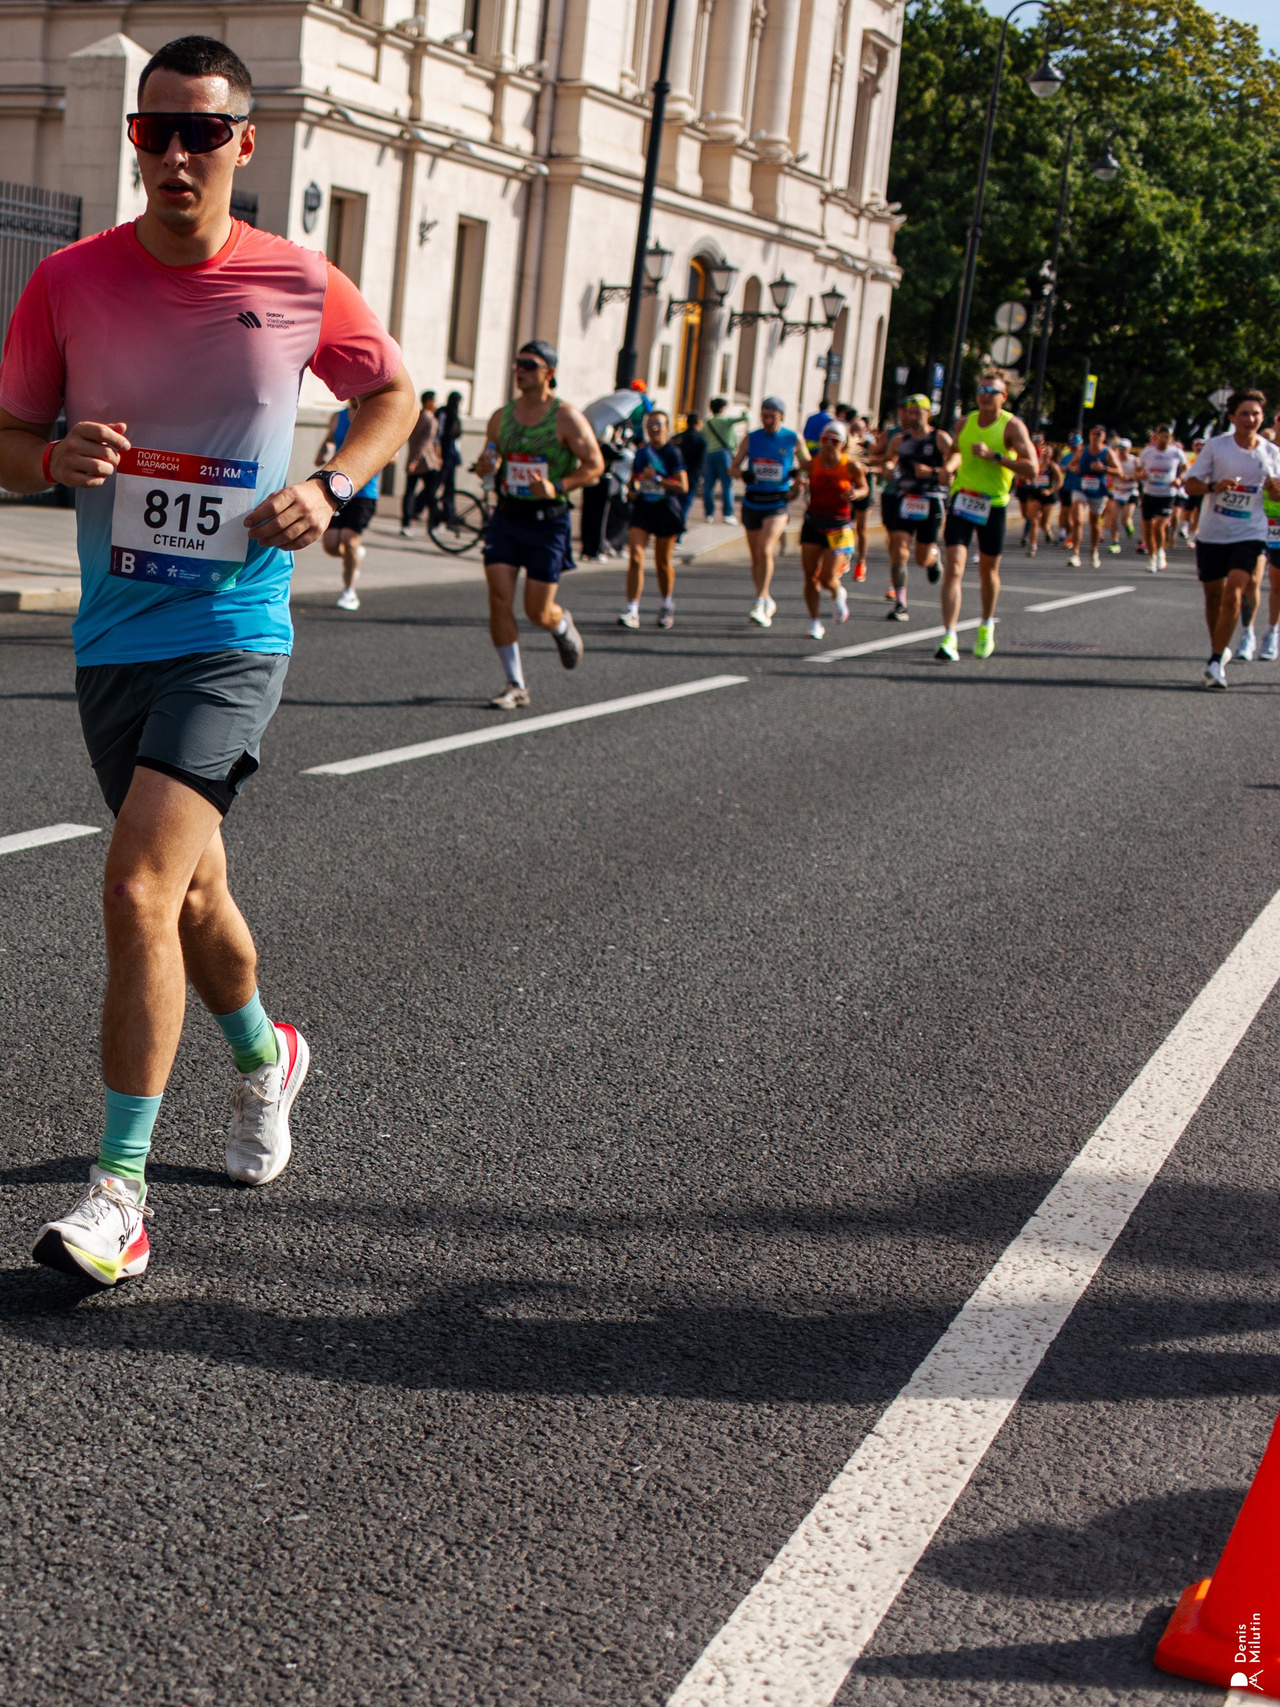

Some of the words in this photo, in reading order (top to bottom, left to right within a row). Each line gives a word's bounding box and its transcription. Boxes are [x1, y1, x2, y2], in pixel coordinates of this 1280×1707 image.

[137, 451, 161, 460] ПОЛУ
[136, 459, 180, 471] МАРАФОН
[199, 465, 219, 478] 21,1
[222, 468, 242, 479] КМ
[1222, 491, 1251, 506] 2371
[143, 489, 224, 536] 815
[153, 534, 205, 551] СТЕПАН
[121, 552, 136, 574] B
